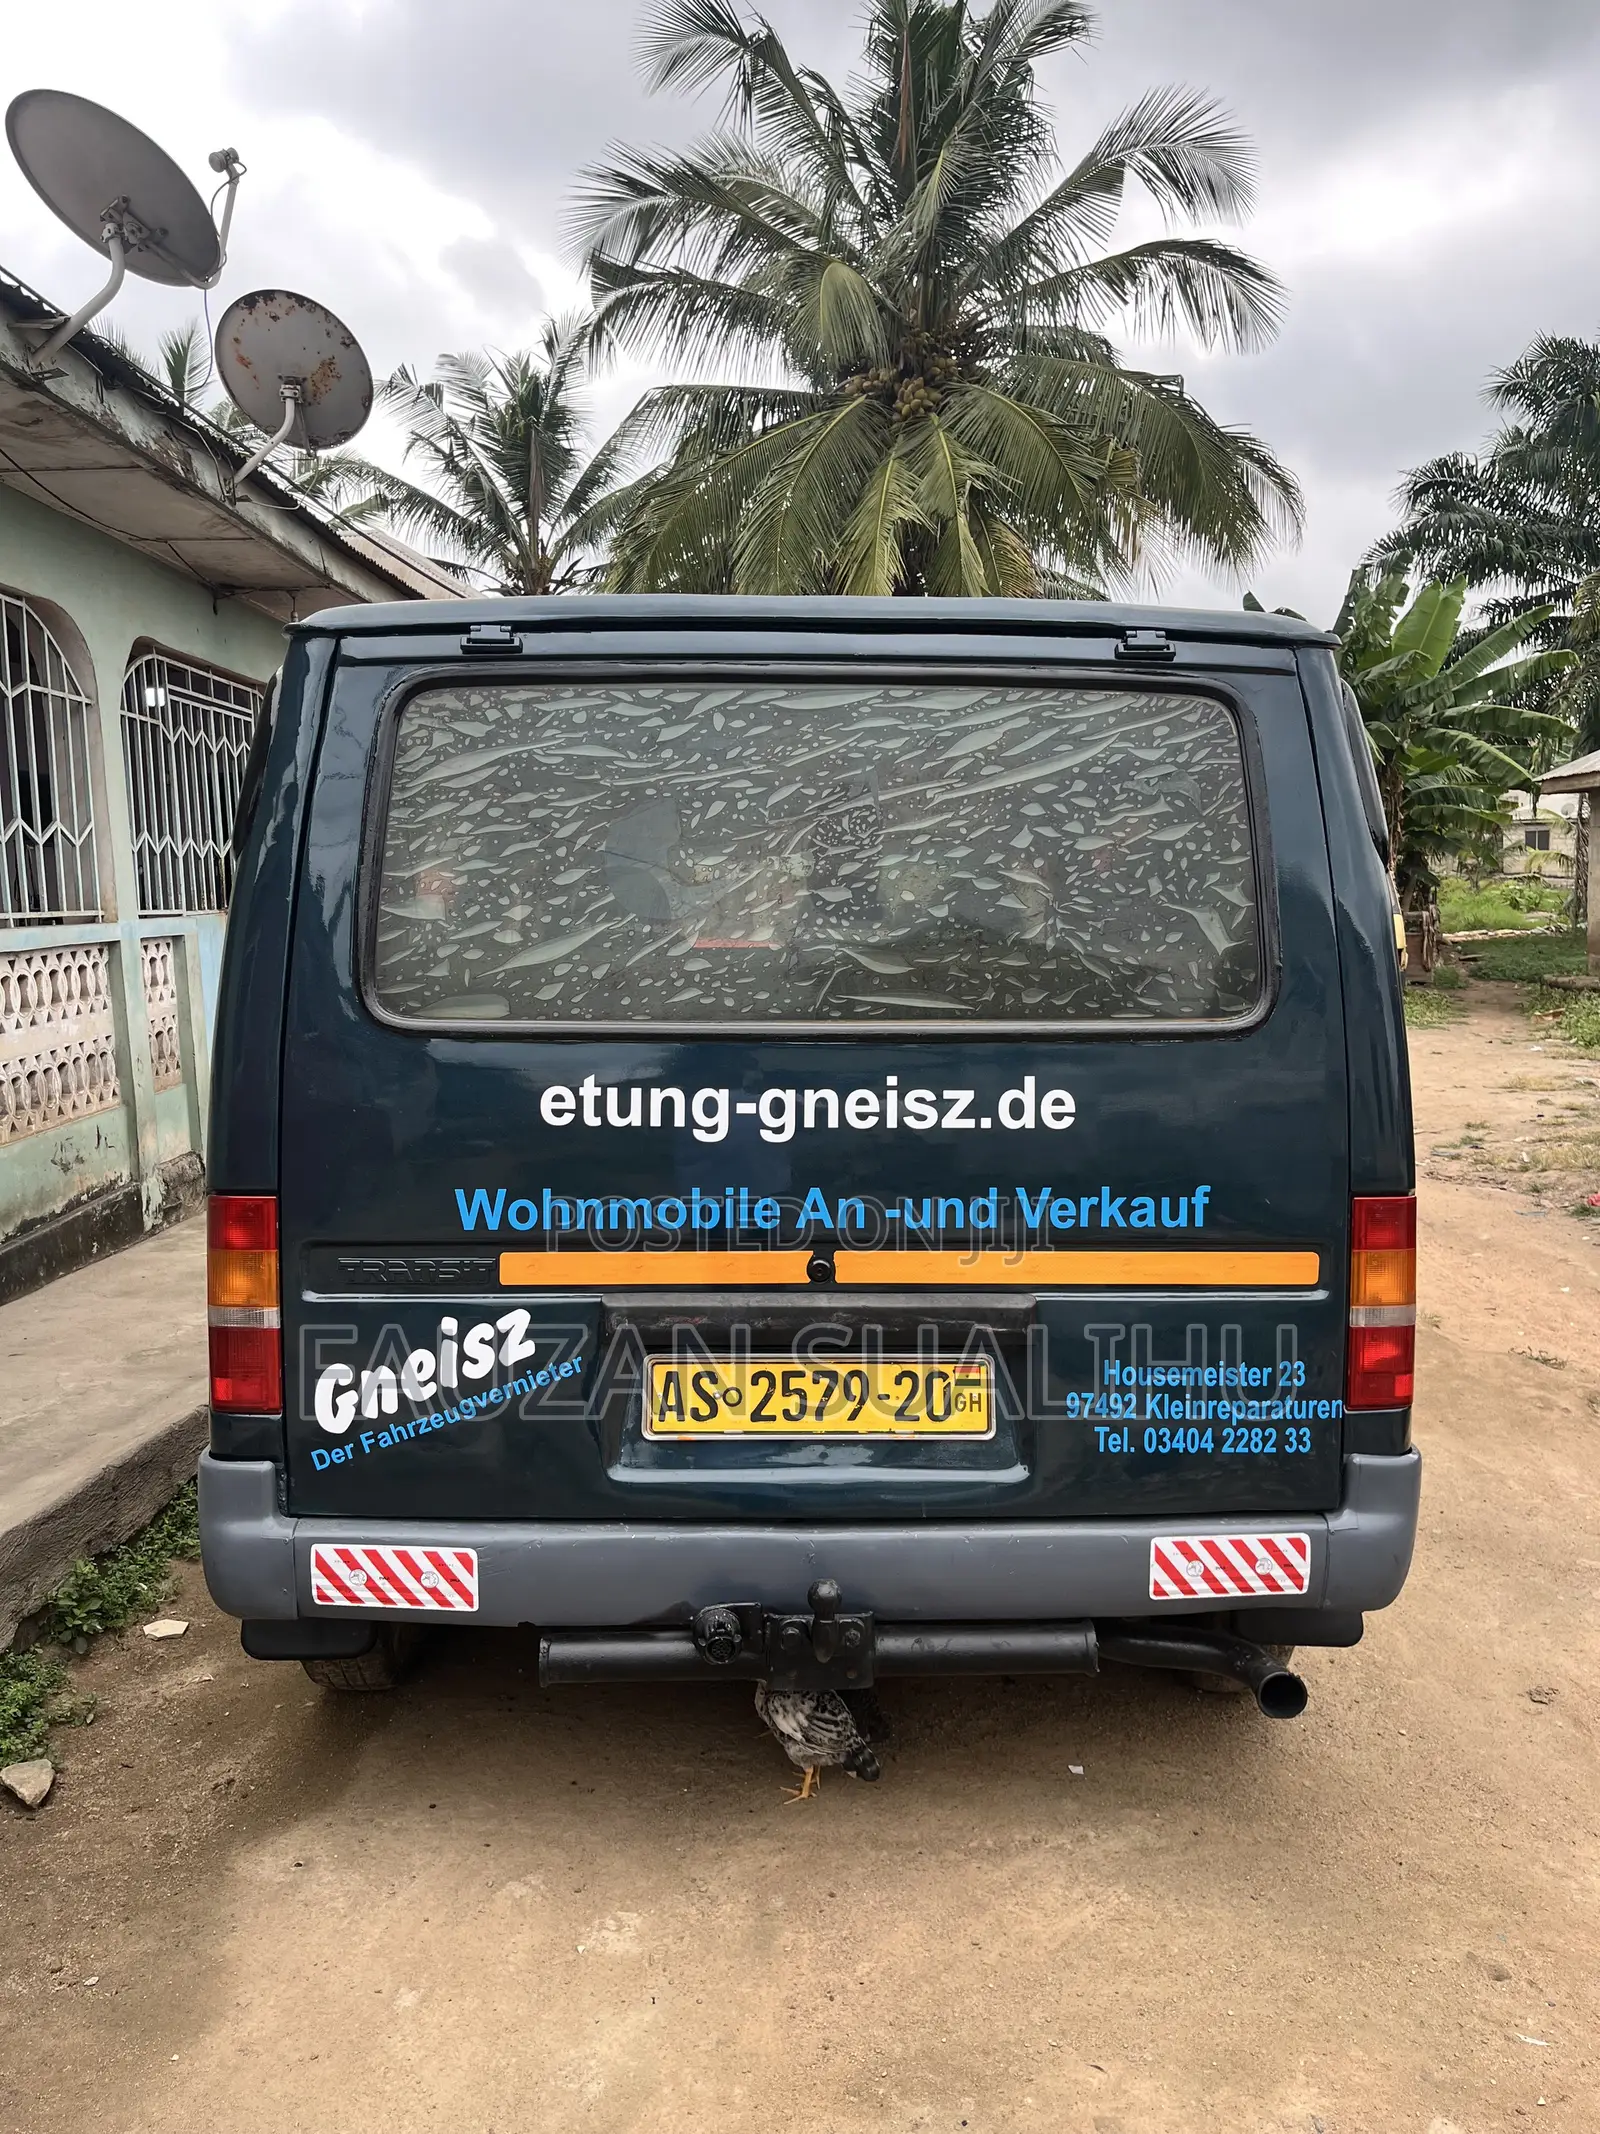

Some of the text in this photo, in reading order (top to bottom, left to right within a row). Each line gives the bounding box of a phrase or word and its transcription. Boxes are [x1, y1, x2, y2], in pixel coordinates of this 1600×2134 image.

[540, 1074, 1077, 1143] etung-gneisz.de
[454, 1185, 1212, 1231] Wohnmobile An -und Verkauf
[314, 1308, 536, 1434] Gneisz
[1103, 1359, 1306, 1387] Housemeister 23
[658, 1370, 953, 1422] AS 2579-20
[954, 1392, 983, 1413] GH
[1065, 1391, 1344, 1426] 97492 Kleinreparaturen
[310, 1442, 355, 1471] Der
[1094, 1426, 1312, 1454] Tel. 03404 2282 33
